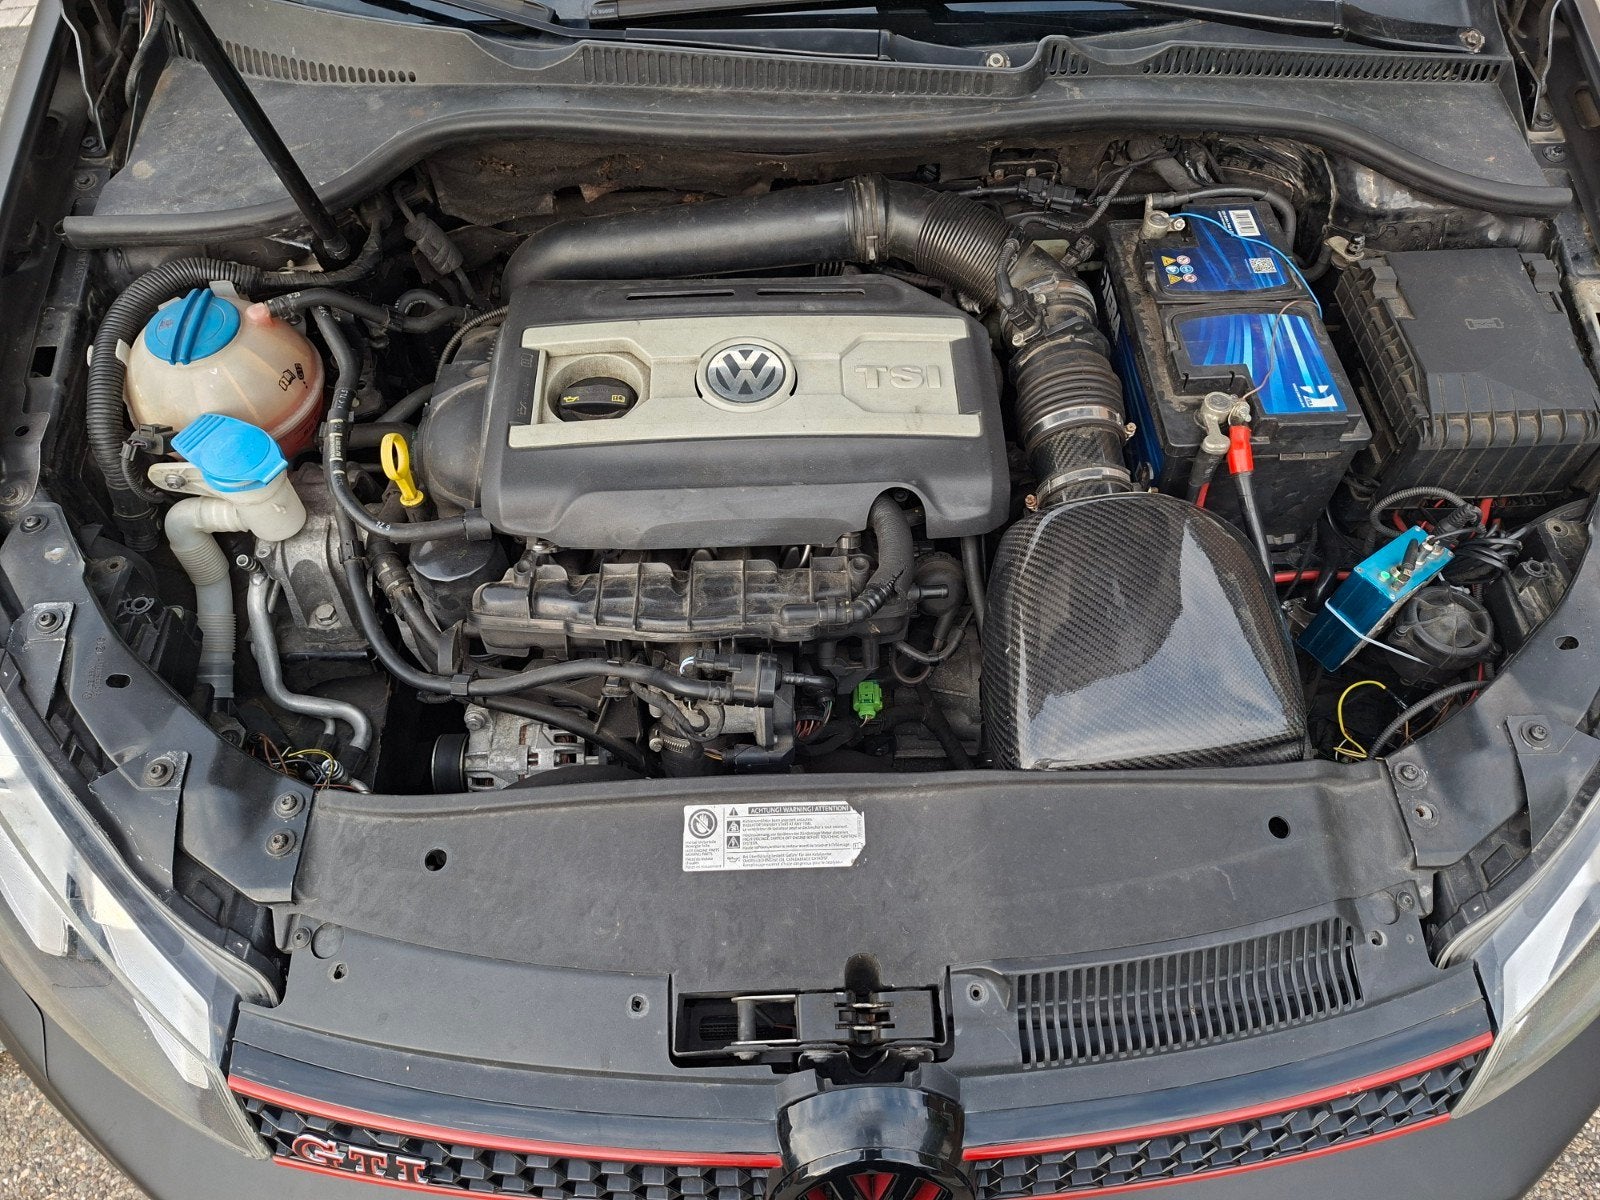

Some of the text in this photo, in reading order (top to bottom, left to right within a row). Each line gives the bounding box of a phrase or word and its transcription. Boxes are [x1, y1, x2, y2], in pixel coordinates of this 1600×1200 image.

[855, 364, 942, 389] TSI
[750, 807, 782, 815] ACHTUNG!
[815, 804, 849, 812] ATTENTION!
[292, 1133, 429, 1184] GTI
